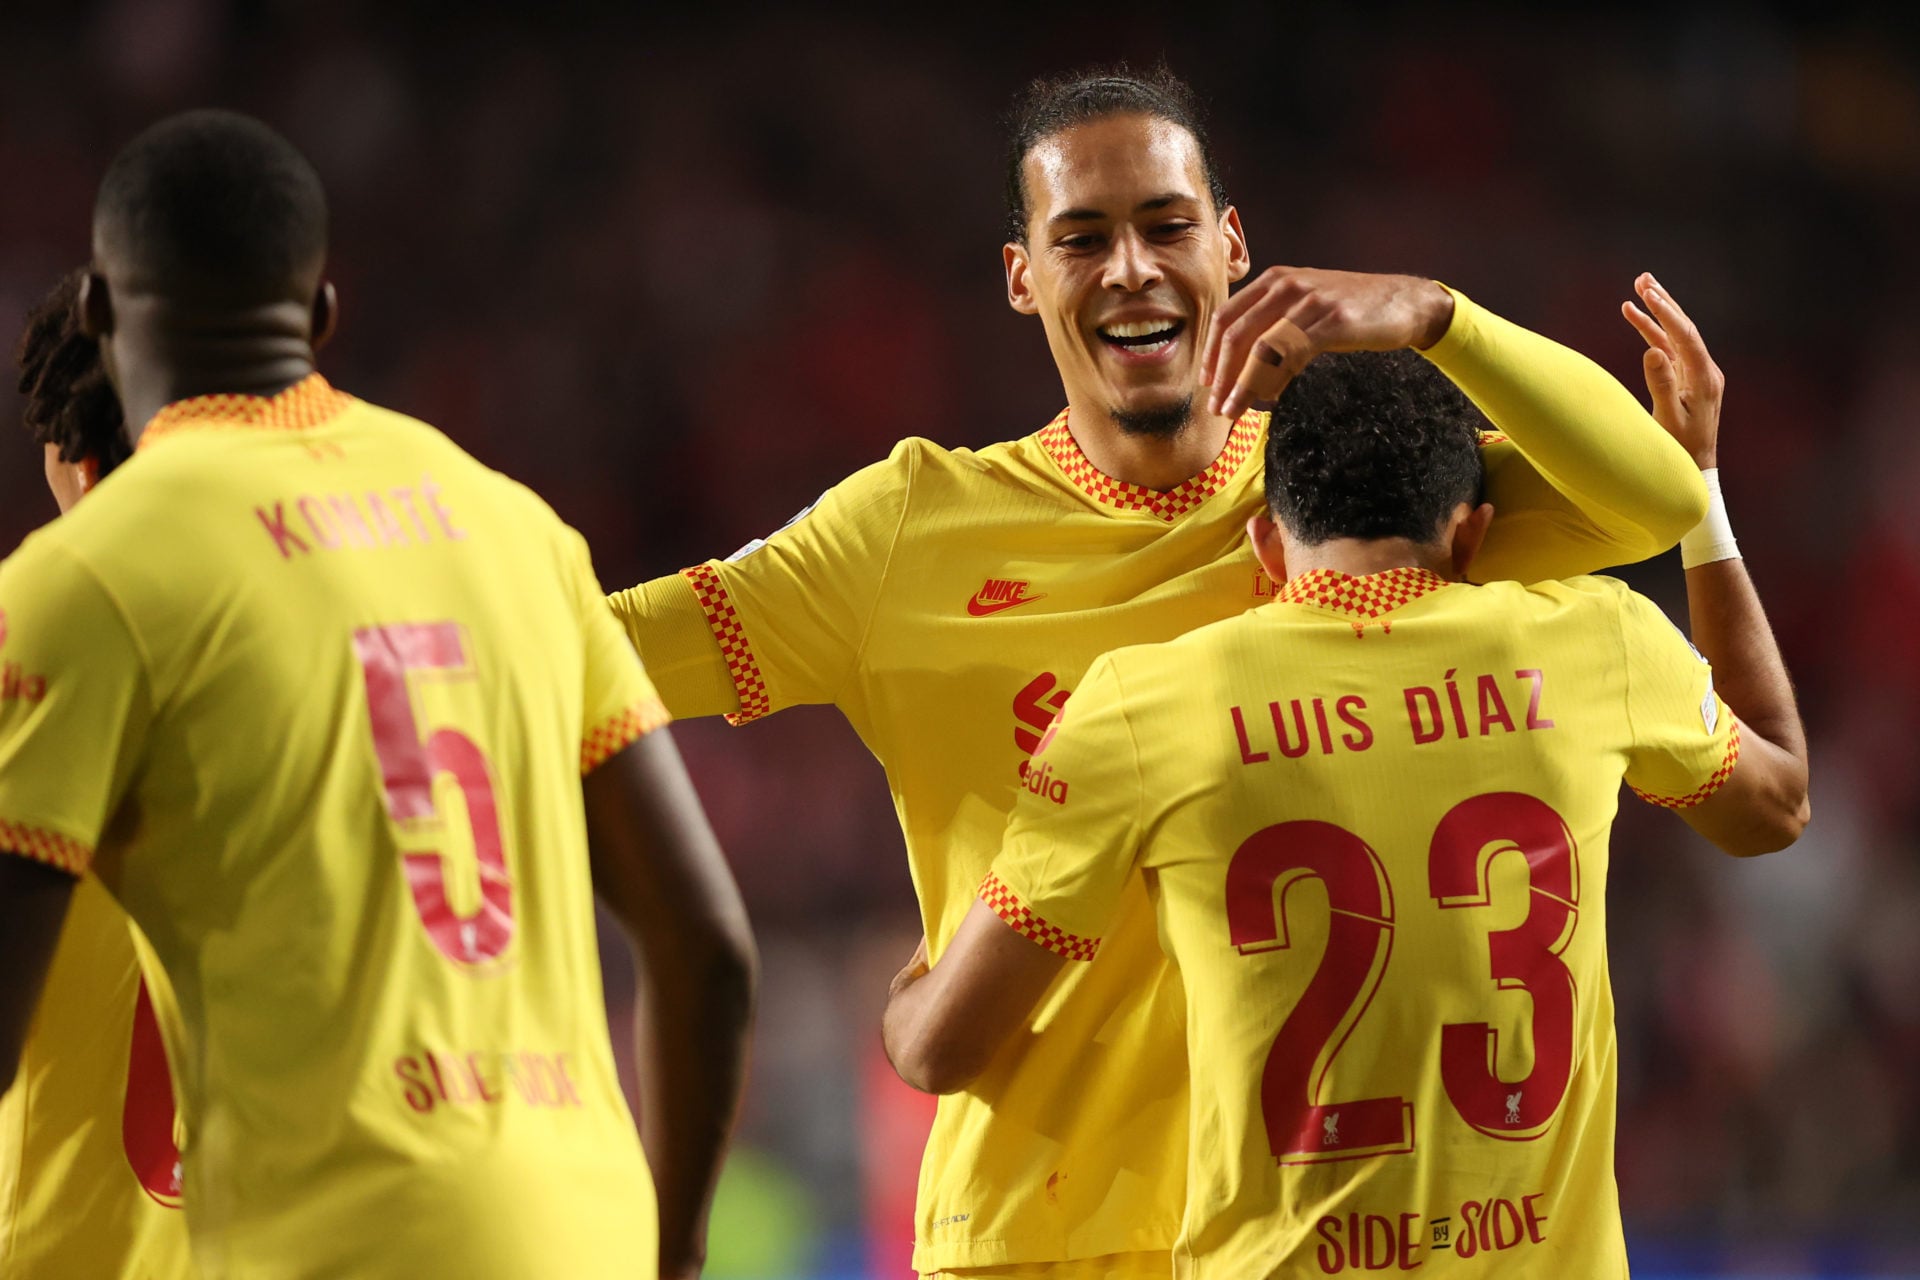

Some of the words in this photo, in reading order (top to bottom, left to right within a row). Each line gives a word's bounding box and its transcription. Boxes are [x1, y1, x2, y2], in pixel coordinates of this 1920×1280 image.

[254, 470, 467, 562] KONATÉ
[979, 578, 1028, 602] NIKE
[1230, 694, 1374, 766] LUIS
[1403, 667, 1555, 746] DÍAZ
[352, 620, 517, 976] 5
[1226, 791, 1580, 1167] 23
[394, 1050, 503, 1114] SIDE
[1316, 1212, 1423, 1275] SIDE
[1433, 1225, 1449, 1242] BY
[1455, 1193, 1548, 1258] SIDE
